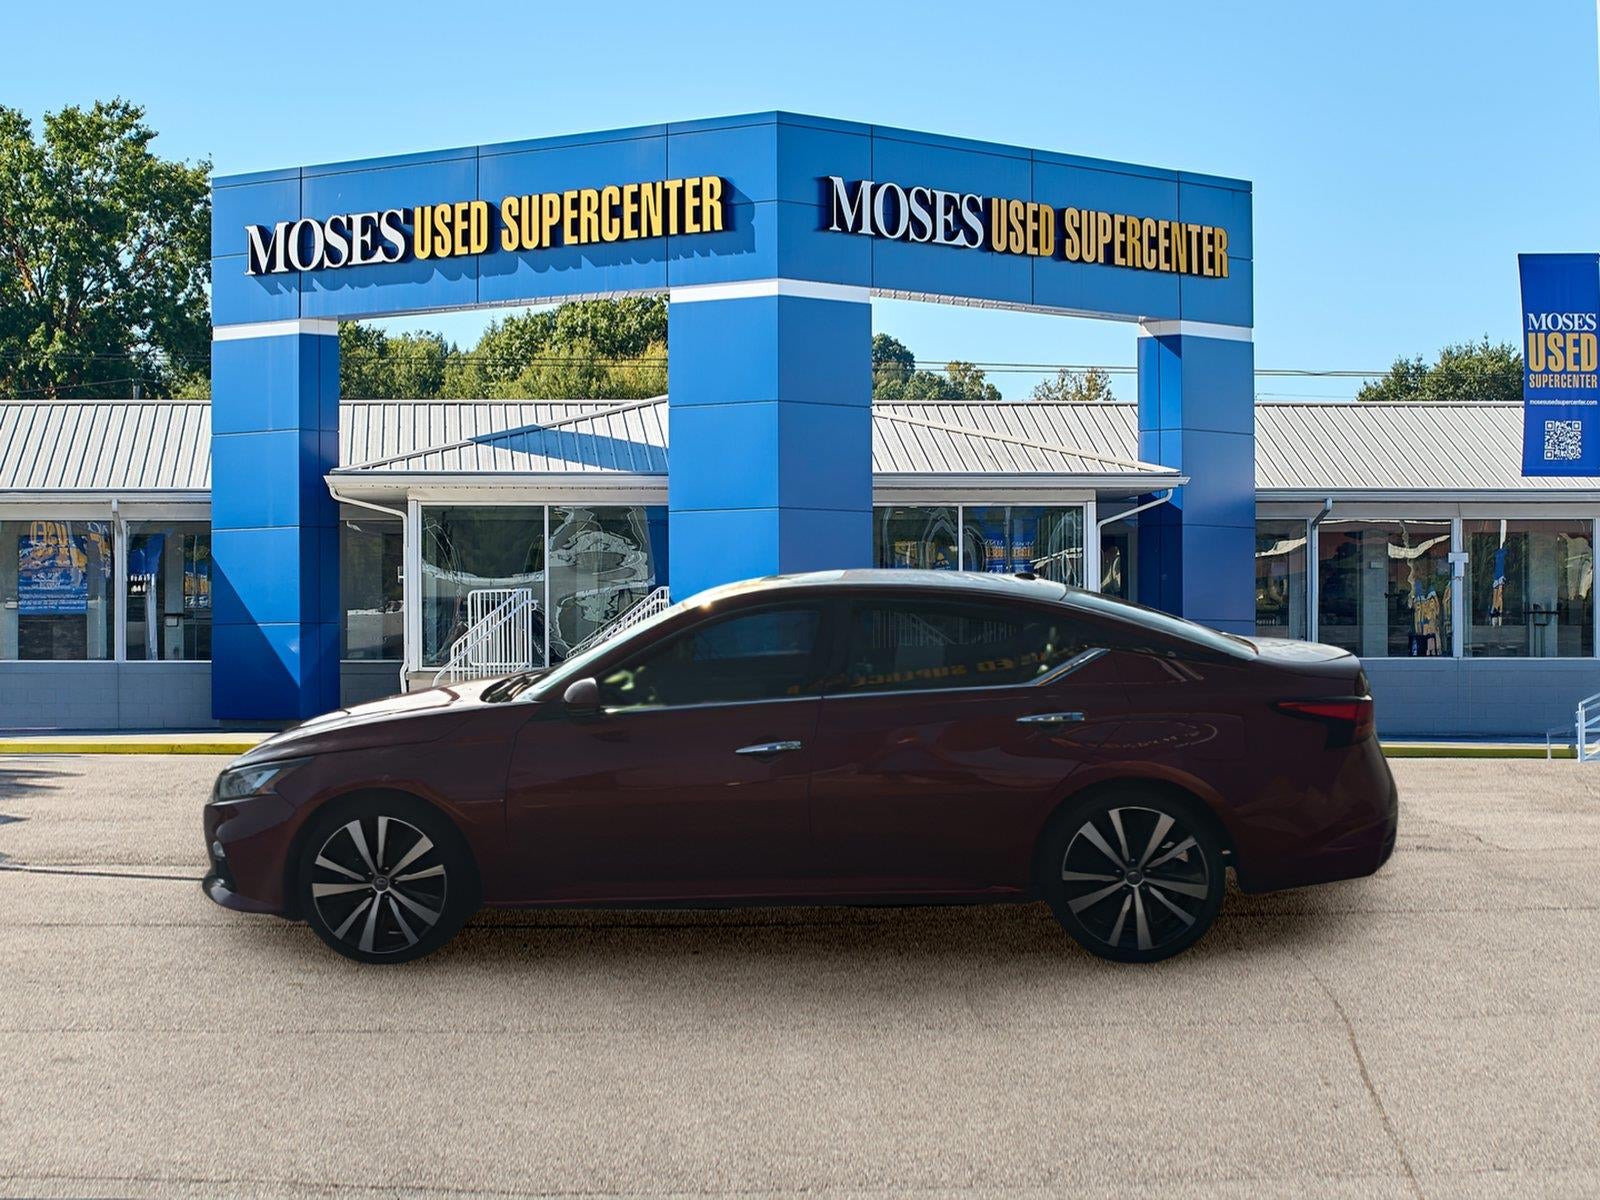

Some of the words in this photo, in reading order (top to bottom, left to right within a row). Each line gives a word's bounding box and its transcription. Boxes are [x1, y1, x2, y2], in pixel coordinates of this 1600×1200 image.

[245, 209, 406, 276] MOSES
[413, 200, 489, 260] USED
[501, 175, 723, 252] SUPERCENTER
[829, 175, 984, 249] MOSES
[990, 197, 1055, 257] USED
[1065, 207, 1229, 278] SUPERCENTER
[1527, 312, 1597, 331] MOSES
[1528, 332, 1598, 372] USED
[1529, 374, 1598, 388] SUPERCENTER
